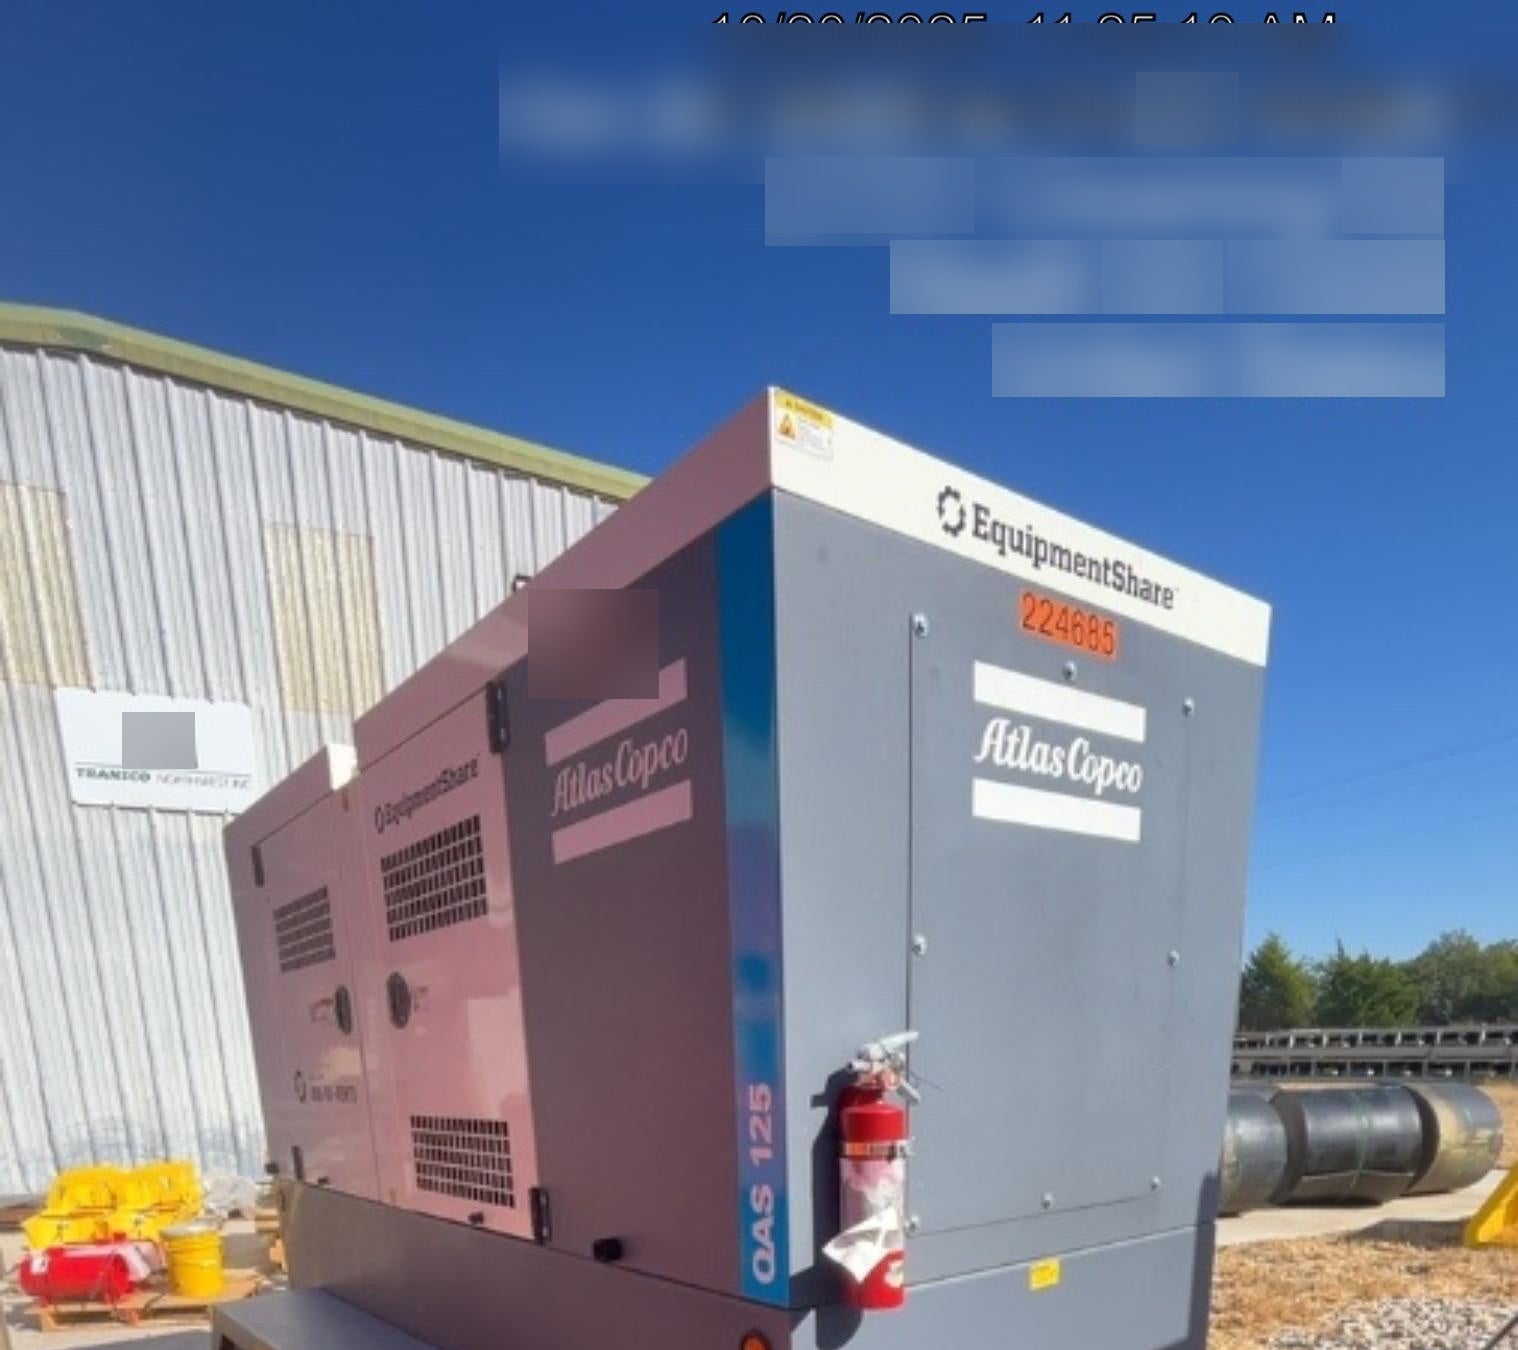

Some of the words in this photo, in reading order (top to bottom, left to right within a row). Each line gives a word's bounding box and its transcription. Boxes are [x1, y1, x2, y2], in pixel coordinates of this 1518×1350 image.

[971, 502, 1175, 610] EquipmentShare
[1020, 591, 1115, 656] 224685
[750, 1082, 773, 1167] 125
[750, 1183, 775, 1285] QAS
